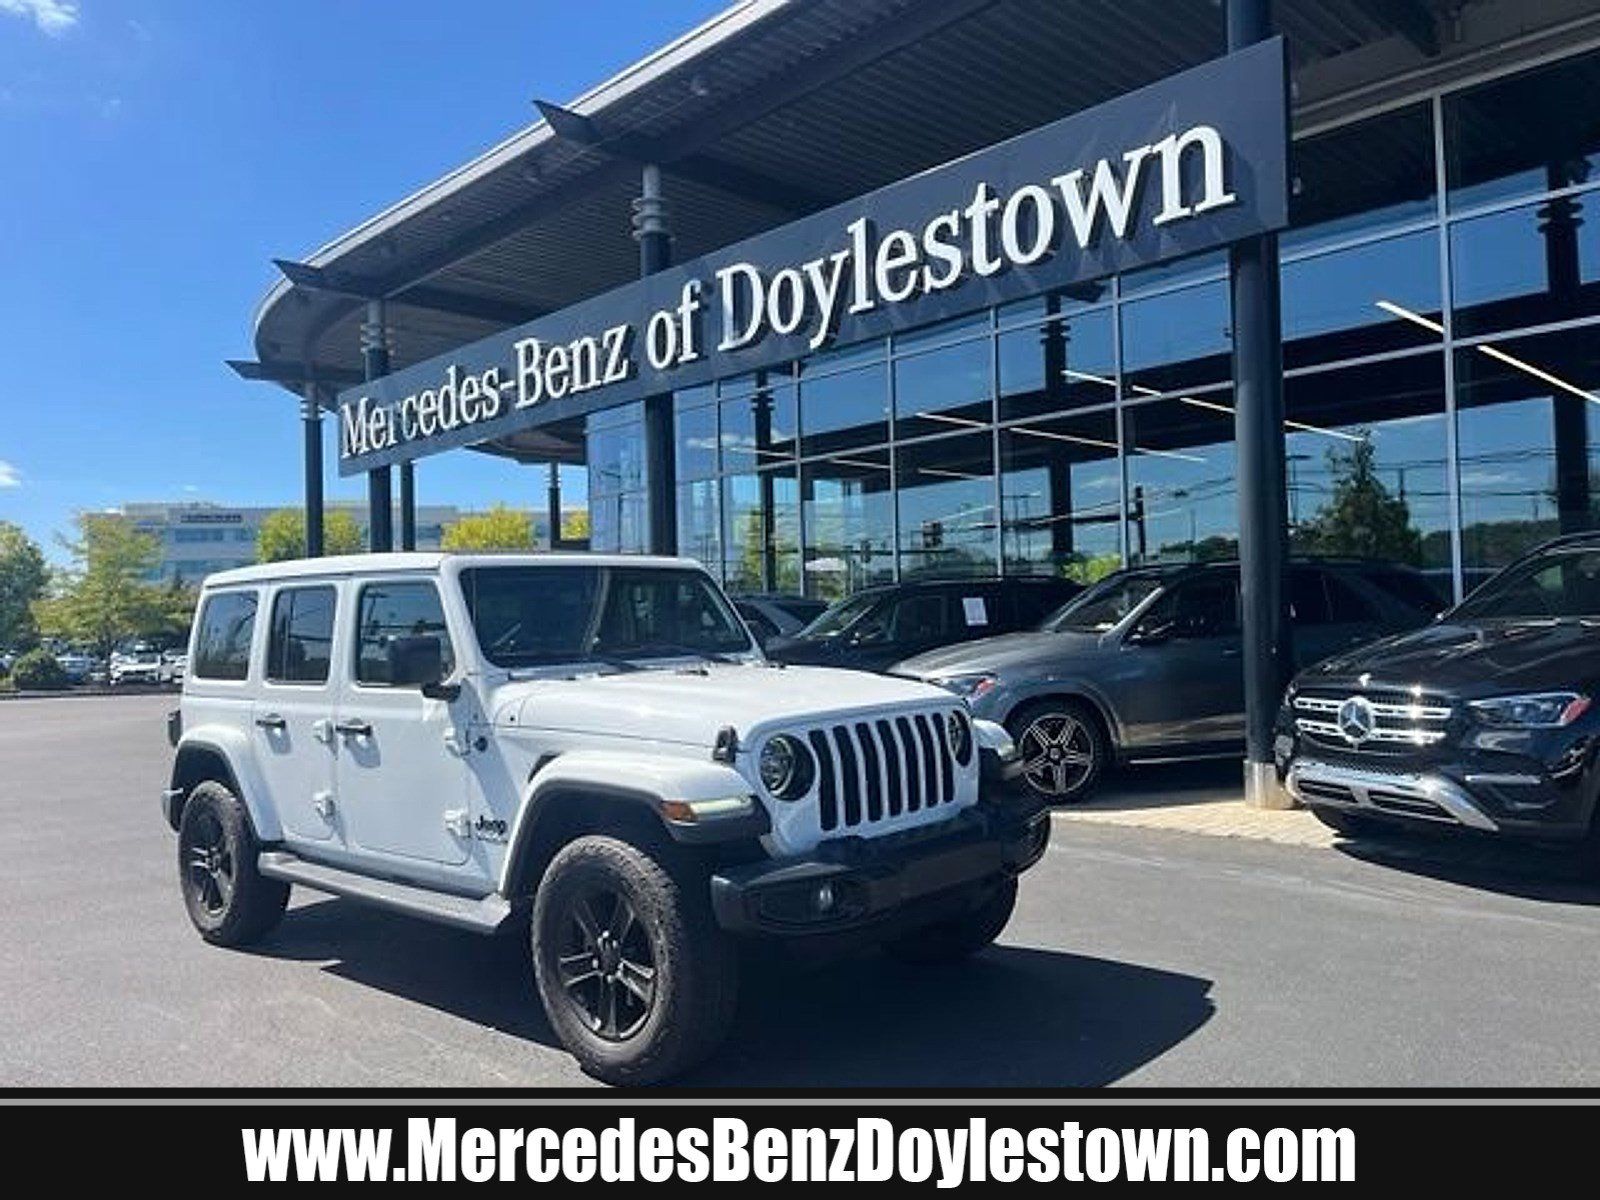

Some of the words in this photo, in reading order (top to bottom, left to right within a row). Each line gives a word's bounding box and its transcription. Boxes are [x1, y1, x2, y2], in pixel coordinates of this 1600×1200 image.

[340, 324, 629, 459] Mercedes-Benz
[646, 278, 701, 370] of
[716, 124, 1236, 350] Doylestown
[475, 814, 506, 836] Jeep
